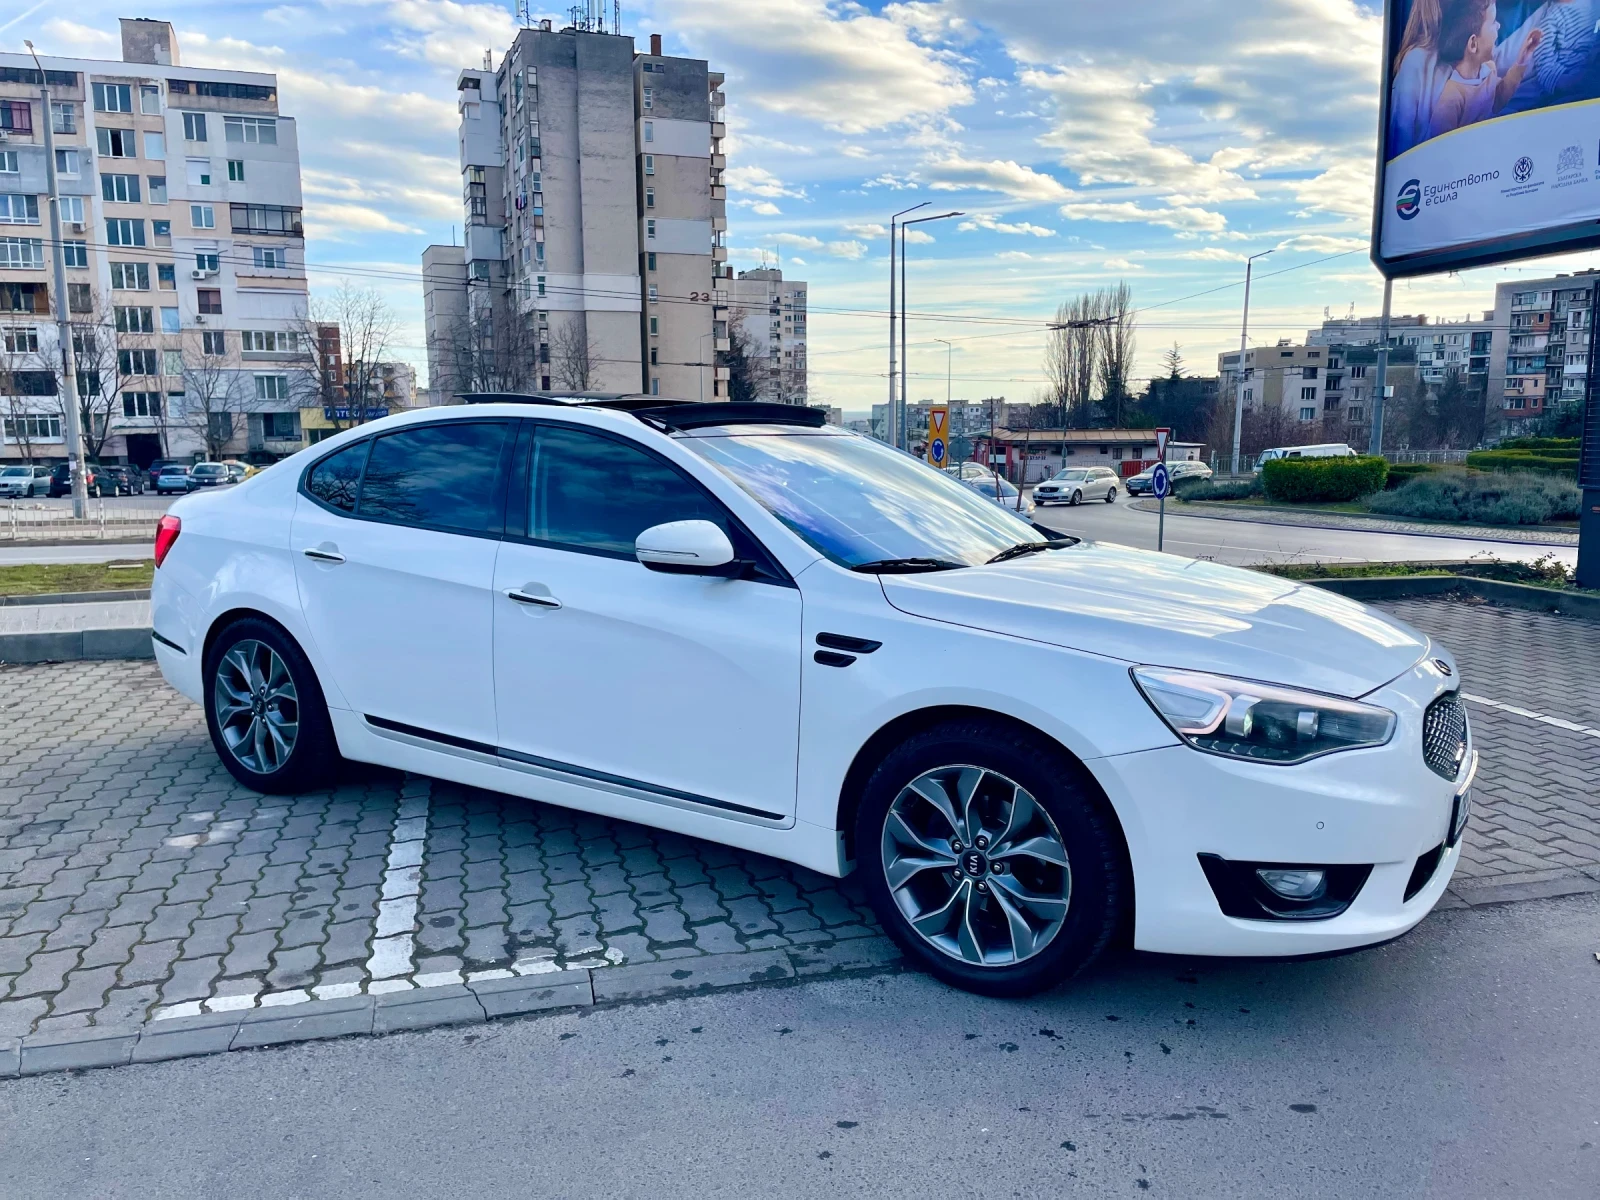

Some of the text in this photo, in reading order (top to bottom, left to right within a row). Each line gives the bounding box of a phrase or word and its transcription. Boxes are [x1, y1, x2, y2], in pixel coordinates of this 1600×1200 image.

[1423, 170, 1500, 197] Единството
[1425, 191, 1458, 206] е сила
[690, 291, 710, 303] 23
